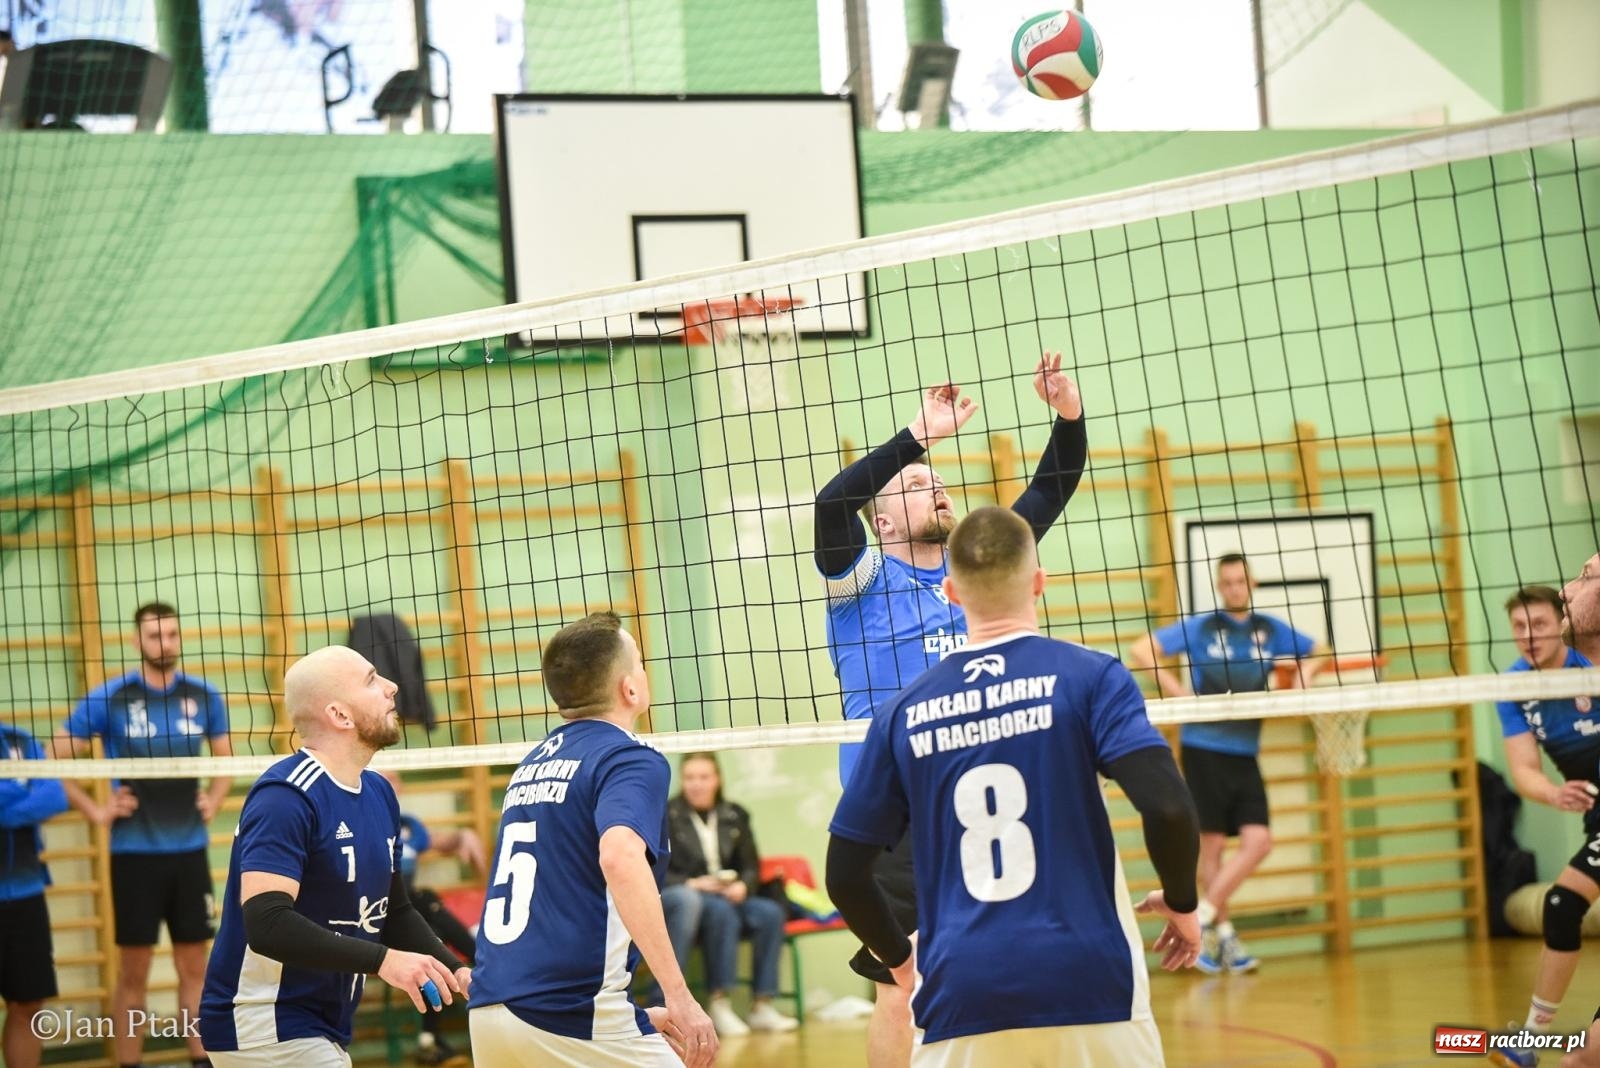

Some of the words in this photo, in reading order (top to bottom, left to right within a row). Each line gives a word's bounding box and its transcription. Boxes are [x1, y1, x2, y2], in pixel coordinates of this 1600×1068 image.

[905, 689, 982, 729] ZAKŁAD
[985, 675, 1057, 709] KARNY
[909, 730, 933, 759] W
[935, 704, 1053, 752] RACIBORZU
[954, 763, 1036, 902] 8
[484, 821, 537, 944] 5
